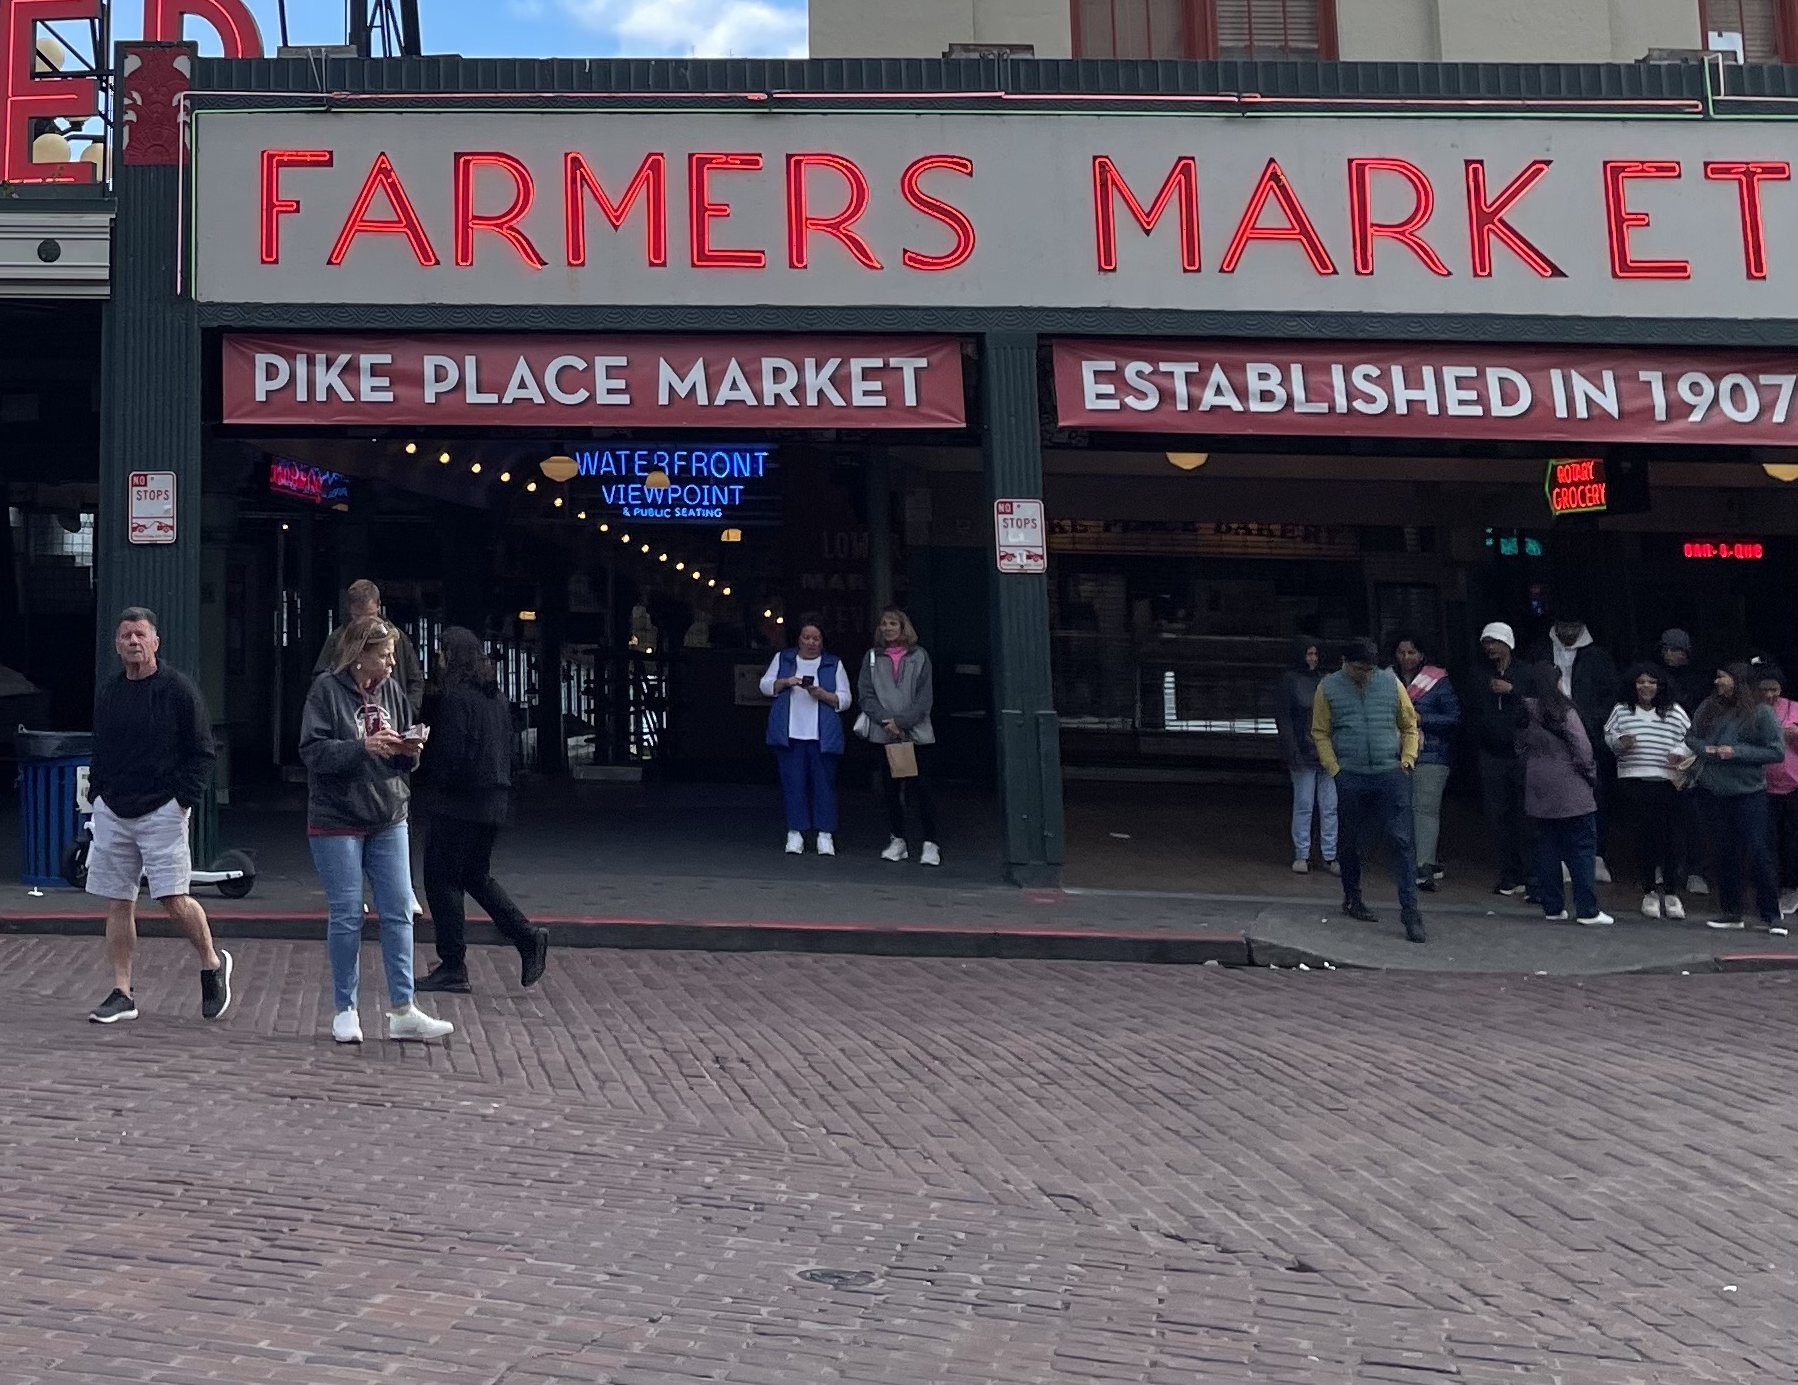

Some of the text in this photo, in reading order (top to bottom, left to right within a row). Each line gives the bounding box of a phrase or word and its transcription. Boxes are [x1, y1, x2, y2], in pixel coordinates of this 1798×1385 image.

[260, 149, 1791, 280] FARMERS MARKET
[255, 352, 929, 407] PIKE PLACE MARKET
[1081, 360, 1797, 424] ESTABLISHED IN 1907
[575, 451, 769, 478] WATERFRONT
[133, 475, 146, 485] NO
[136, 489, 170, 501] STOPS
[602, 484, 745, 506] VIEWPOINT
[1553, 482, 1606, 510] GROCERY
[634, 508, 671, 518] PUBLIC
[675, 508, 722, 518] SEATING
[998, 503, 1011, 513] NO
[1003, 517, 1038, 529] STOPS
